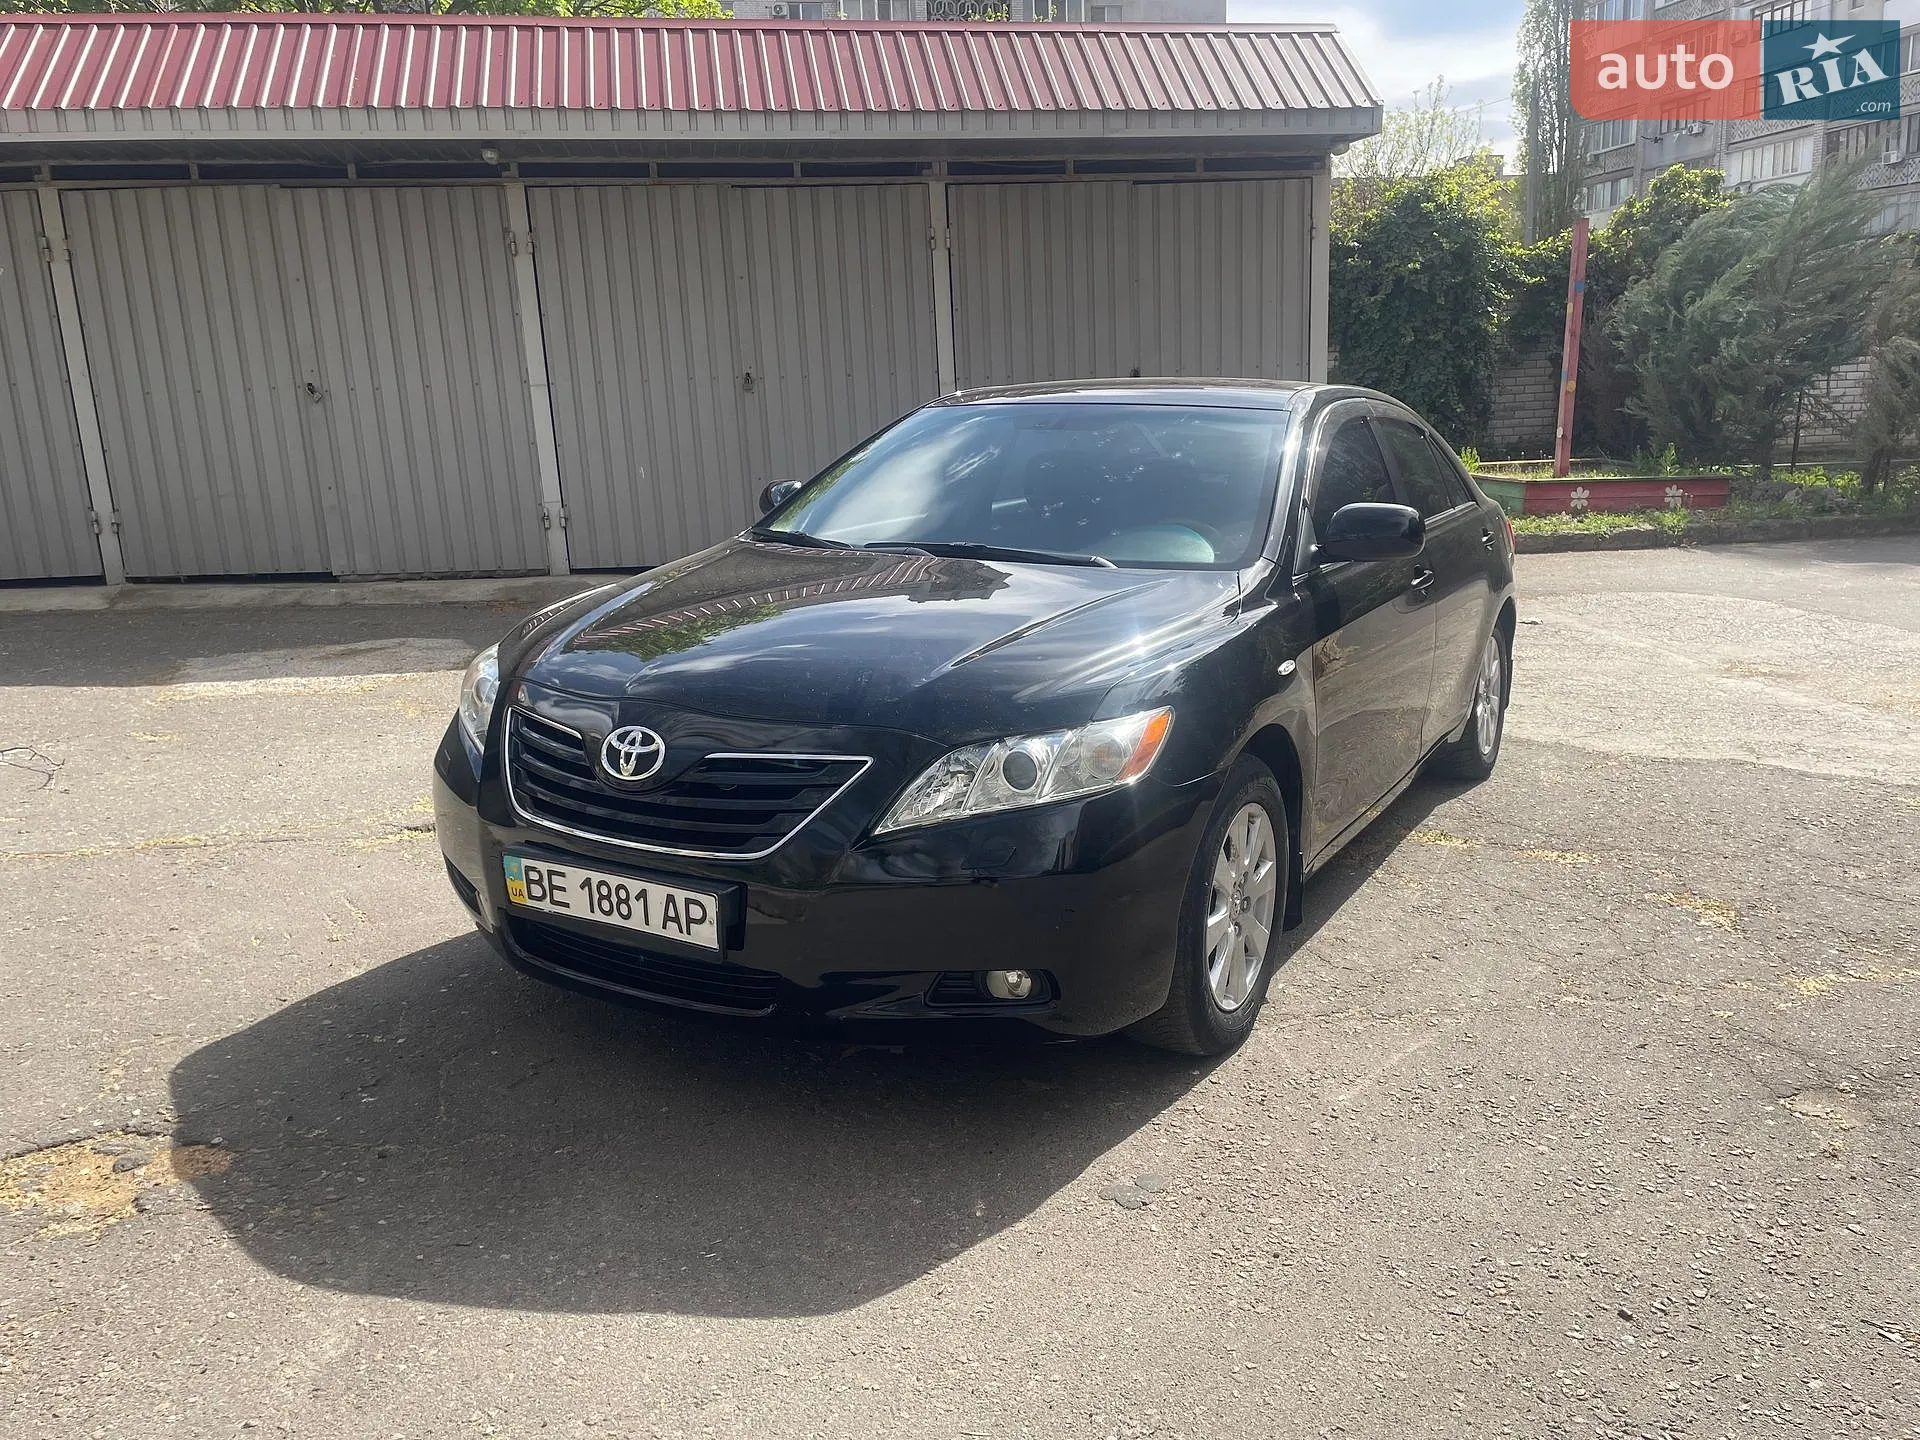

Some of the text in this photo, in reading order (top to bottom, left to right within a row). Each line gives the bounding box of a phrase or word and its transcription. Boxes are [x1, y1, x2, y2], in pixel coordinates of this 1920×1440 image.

[511, 887, 525, 898] UA
[524, 865, 708, 935] BE 1881 AP
